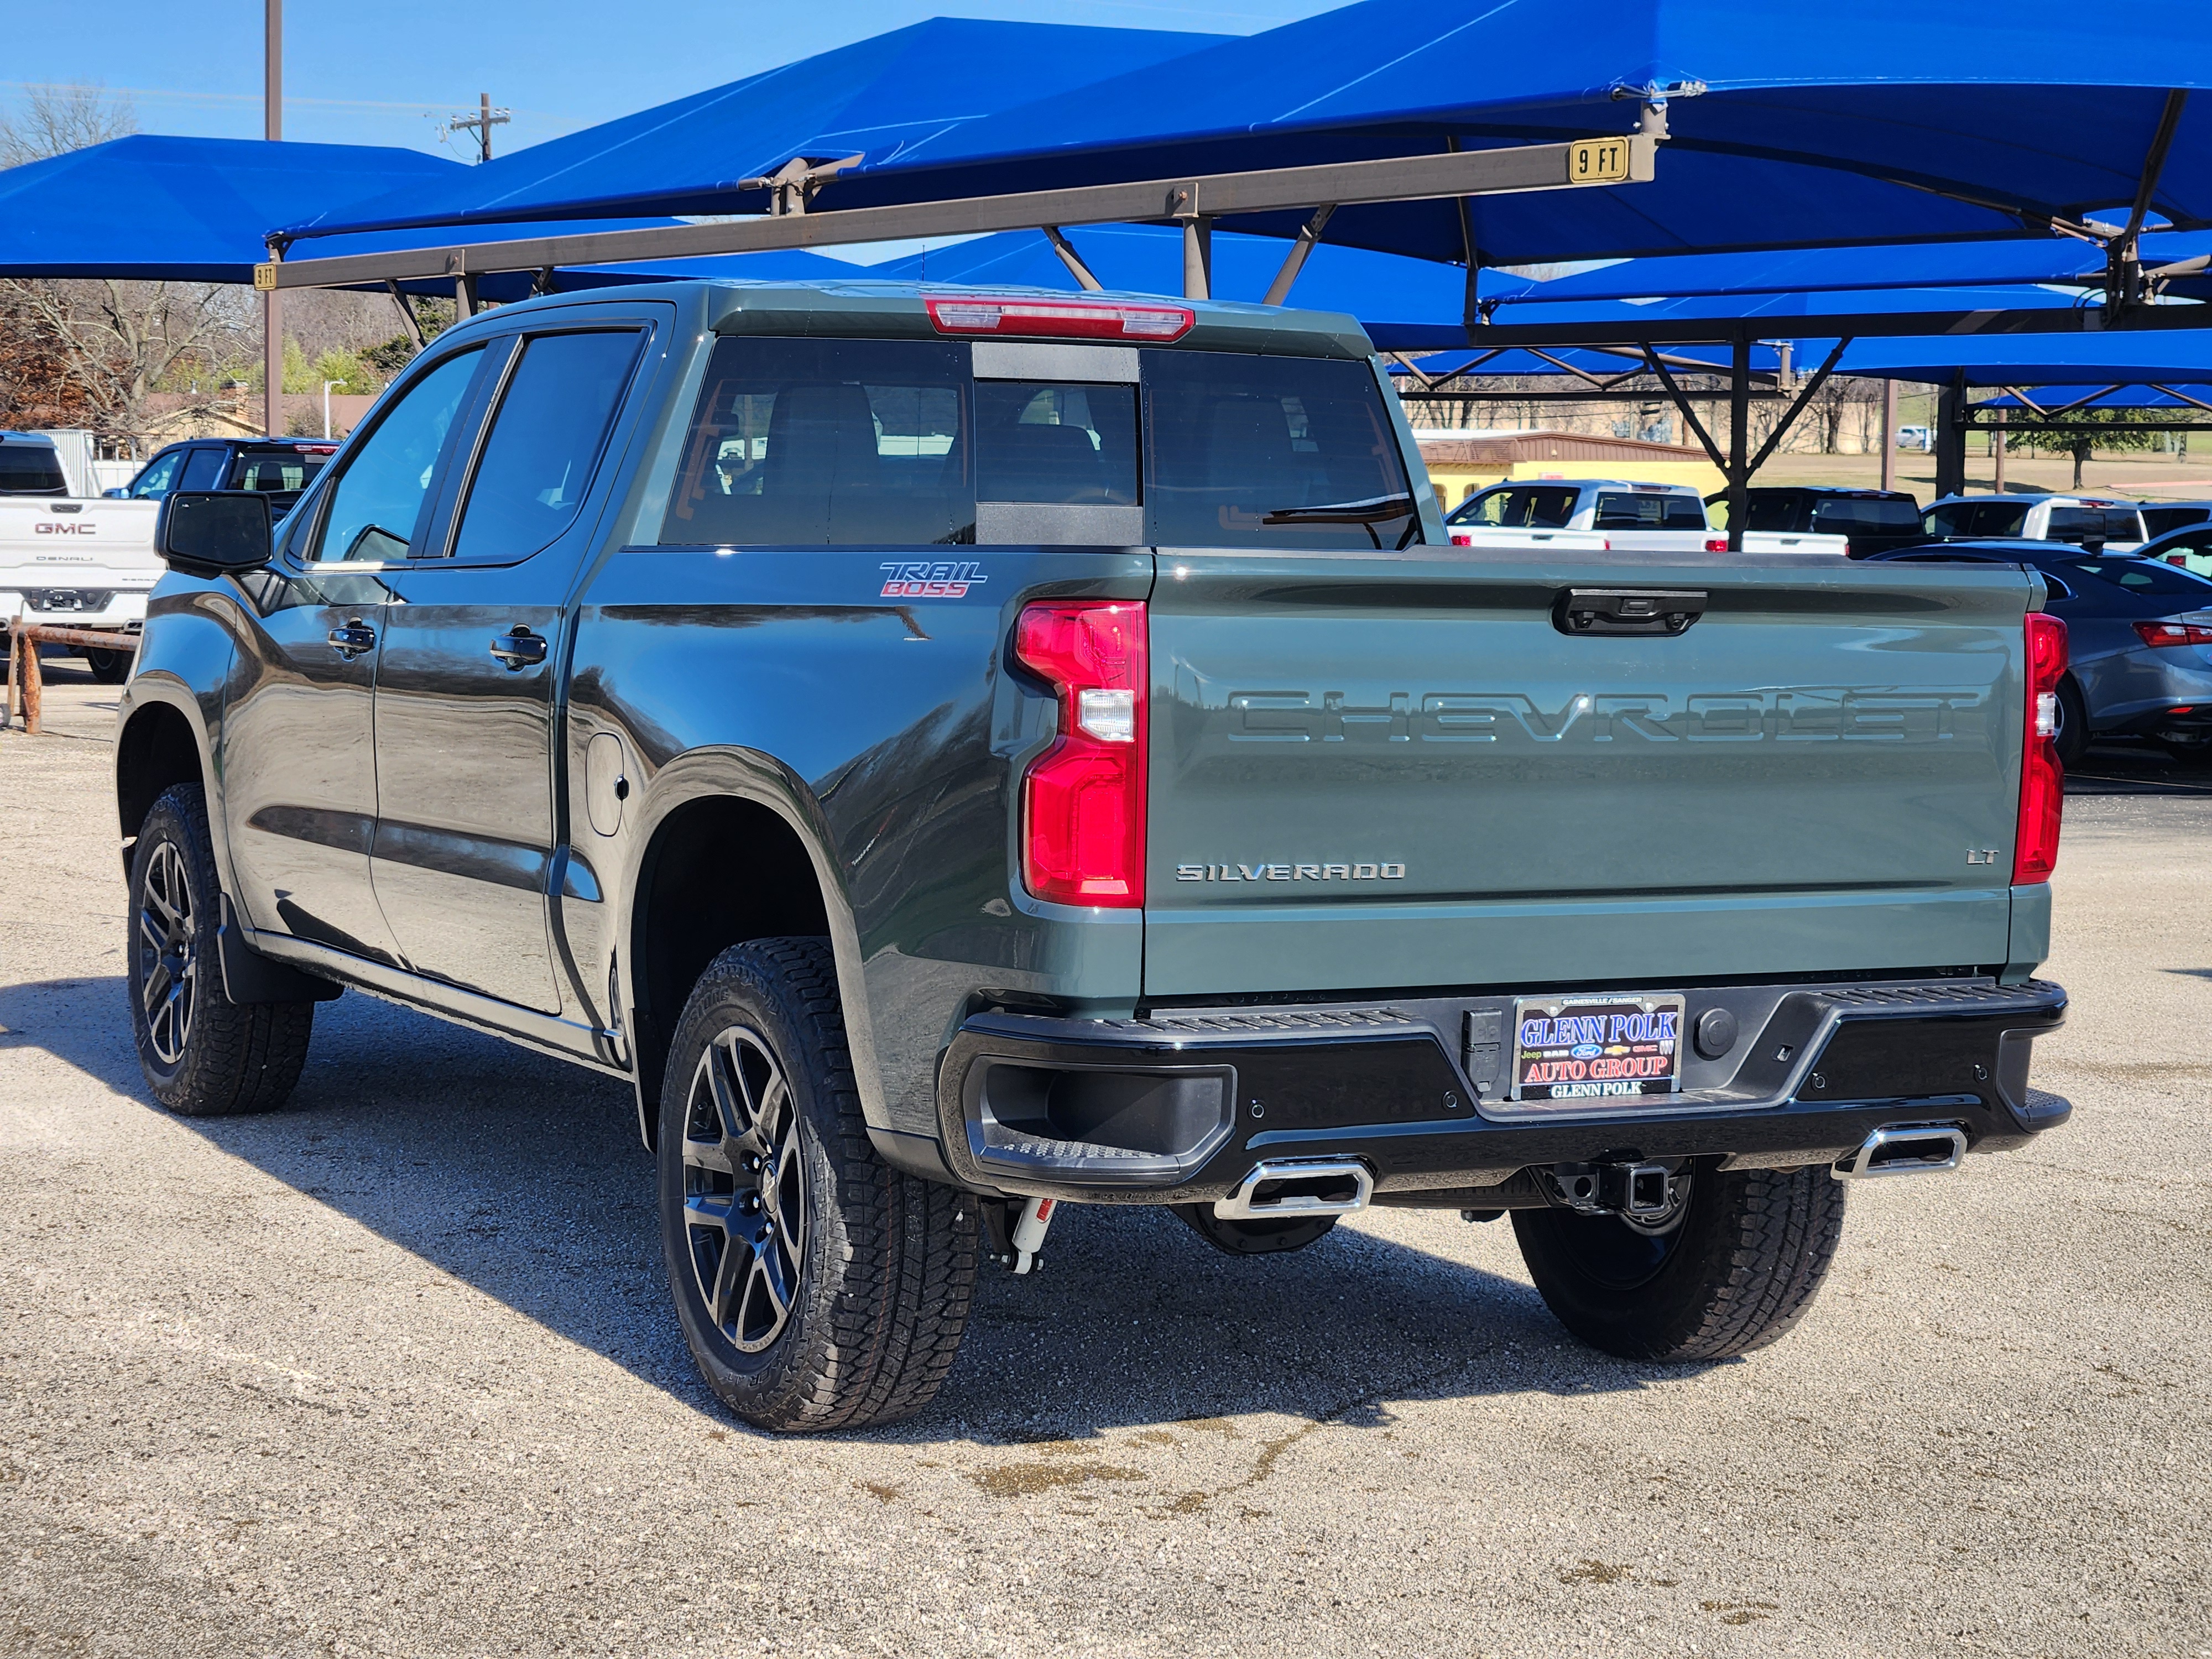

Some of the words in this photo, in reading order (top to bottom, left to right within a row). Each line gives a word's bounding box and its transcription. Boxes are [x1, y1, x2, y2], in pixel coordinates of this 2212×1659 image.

[1579, 149, 1588, 174] 9
[258, 269, 262, 284] 9
[35, 523, 96, 535] GMC
[879, 562, 989, 583] TRAIL
[880, 581, 970, 598] BOSS
[1228, 690, 1980, 742] CHEVROLET
[1966, 848, 2000, 864] LT
[1176, 862, 1406, 881] SILVERADO
[1520, 1015, 1608, 1047] GLENN
[1608, 1011, 1678, 1042] POLK
[1521, 1050, 1542, 1060] Jeep
[1525, 1060, 1587, 1083] AUTO
[1590, 1056, 1668, 1079] GROUP
[1551, 1083, 1602, 1099] GLENN
[1602, 1081, 1642, 1096] POLK
